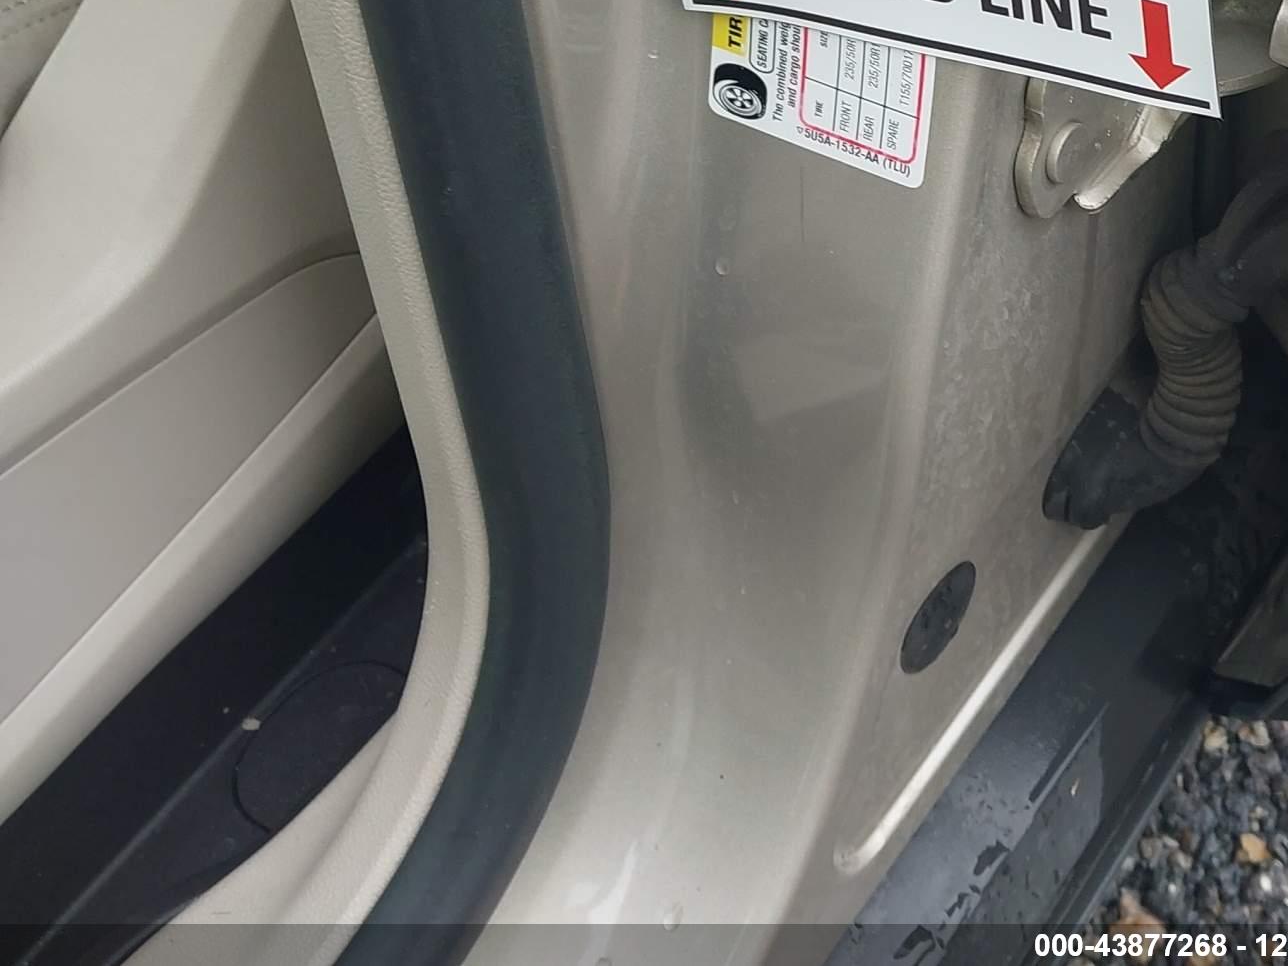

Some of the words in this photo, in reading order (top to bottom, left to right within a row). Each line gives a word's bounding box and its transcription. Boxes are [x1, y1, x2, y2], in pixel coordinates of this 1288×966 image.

[756, 30, 768, 68] SEATING
[775, 48, 788, 101] combined
[789, 54, 801, 86] cargo
[772, 102, 783, 122] The
[787, 87, 797, 108] and
[814, 100, 824, 117] TIRE
[839, 100, 852, 133] FRONT
[862, 116, 875, 142] REAR
[886, 119, 900, 151] SPARE
[882, 157, 911, 178] (TLU)
